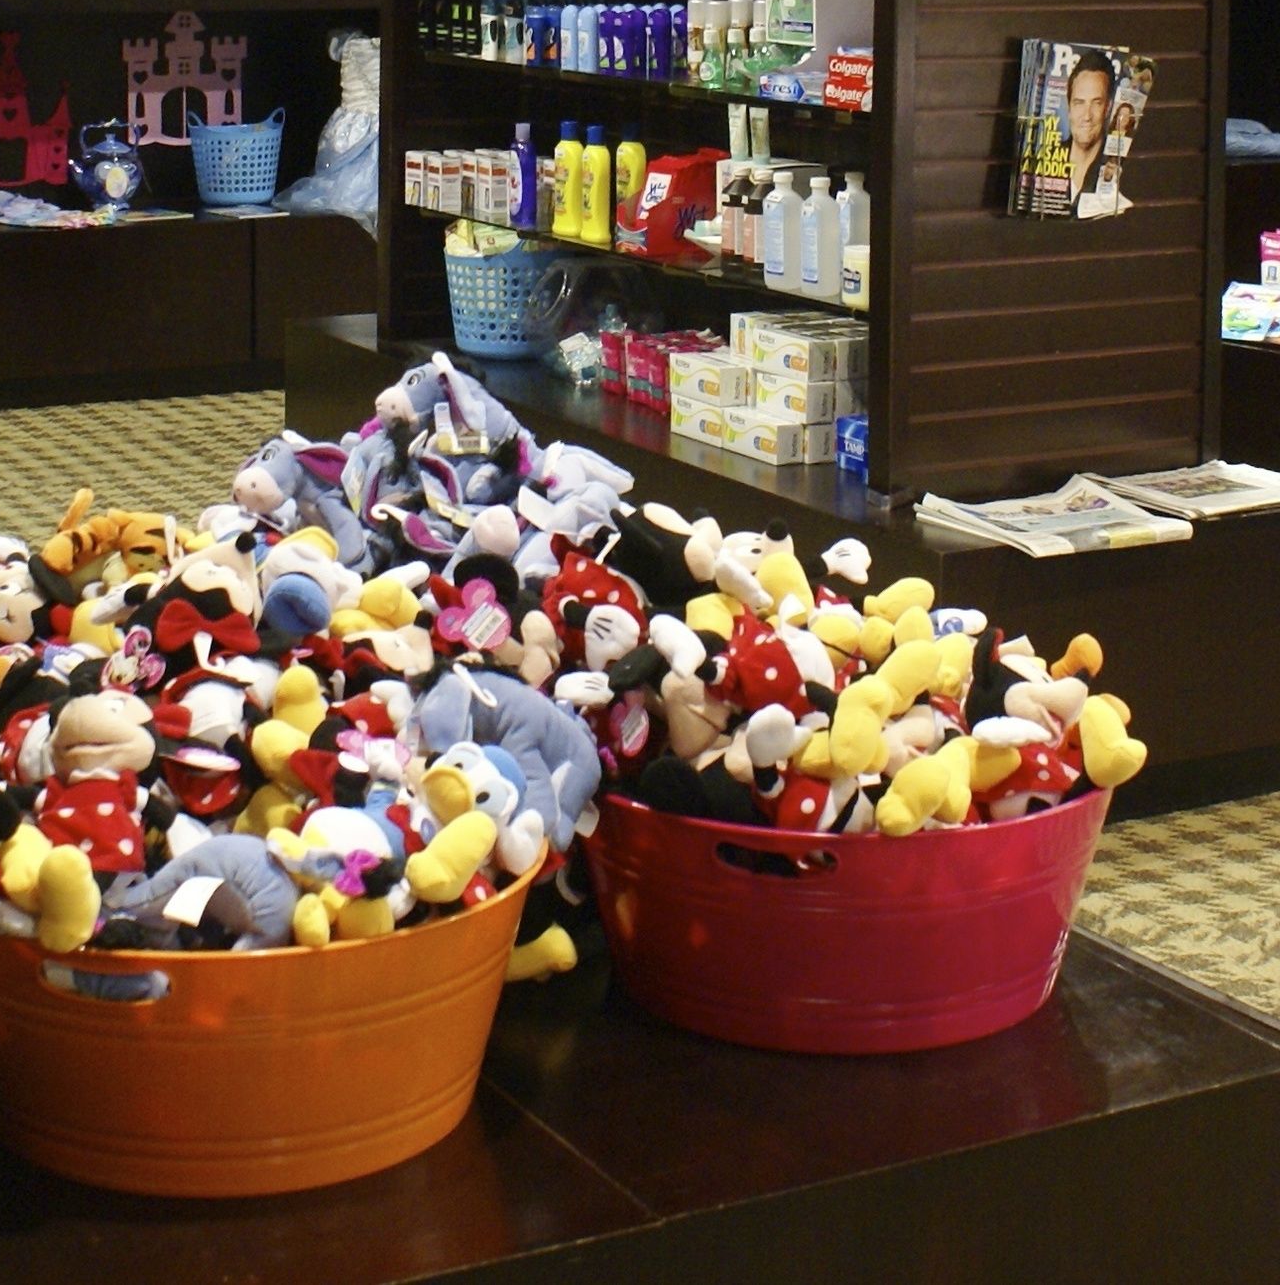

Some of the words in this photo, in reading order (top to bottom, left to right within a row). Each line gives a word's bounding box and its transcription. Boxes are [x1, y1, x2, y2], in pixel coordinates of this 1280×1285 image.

[829, 58, 868, 78] Colgate
[761, 80, 798, 95] Crest
[1035, 161, 1076, 178] ADDICT
[729, 413, 745, 425] Kotex
